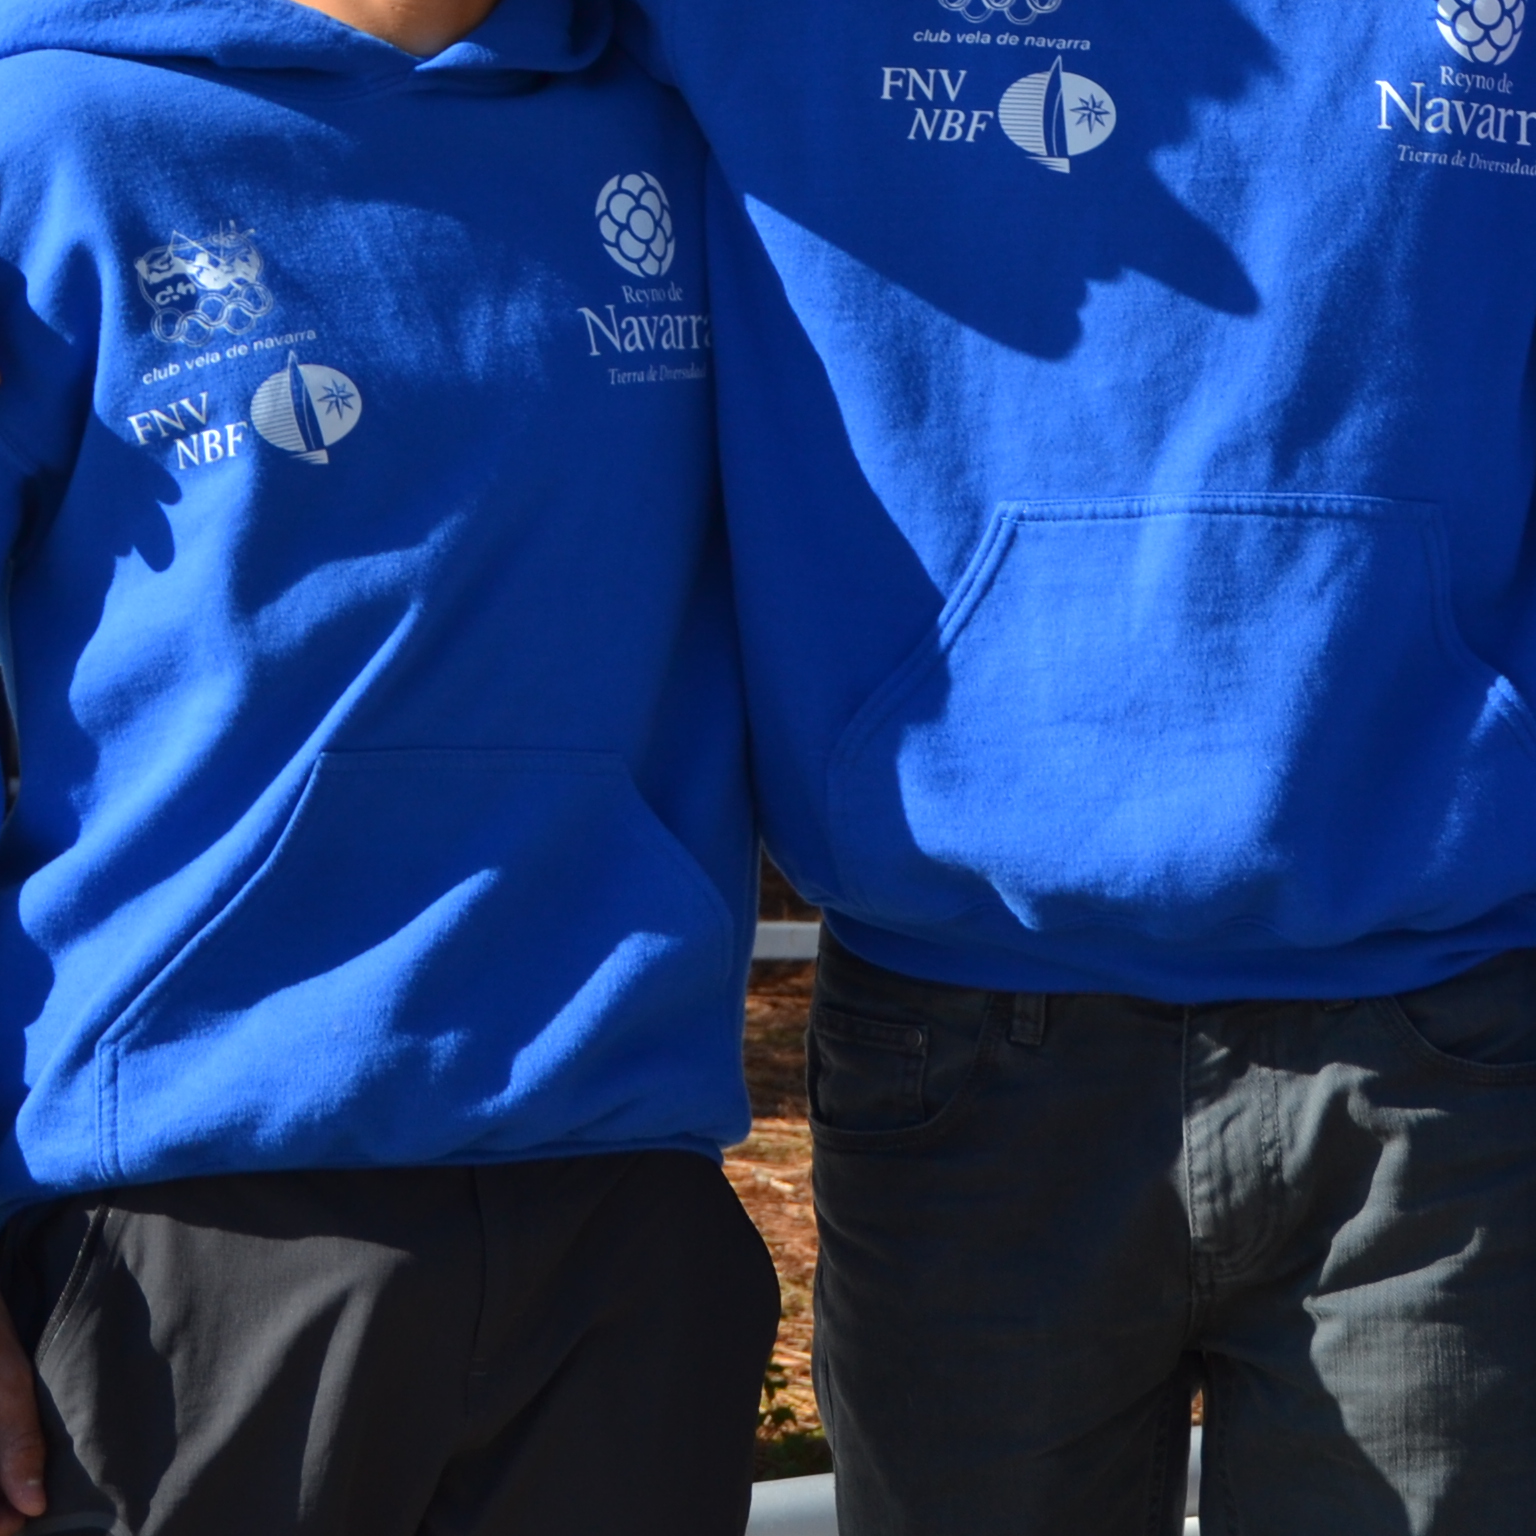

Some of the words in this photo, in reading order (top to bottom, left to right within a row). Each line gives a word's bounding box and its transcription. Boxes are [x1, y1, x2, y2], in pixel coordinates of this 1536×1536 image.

[913, 29, 951, 43] club
[956, 30, 991, 44] vela
[996, 32, 1019, 45] de
[1024, 35, 1091, 51] navarra
[880, 66, 967, 102] FNV
[1440, 65, 1495, 93] Reyno
[1497, 72, 1514, 94] de
[907, 107, 994, 143] NBF
[1397, 144, 1449, 165] Tierra
[1450, 149, 1466, 168] de
[621, 284, 665, 308] Reyno
[667, 281, 683, 302] de
[142, 362, 181, 385] club
[185, 350, 221, 371] vela
[225, 342, 249, 360] de
[253, 328, 317, 351] navarra
[607, 367, 645, 385] Tierra
[127, 391, 209, 445] FNV
[173, 421, 249, 470] NBF
